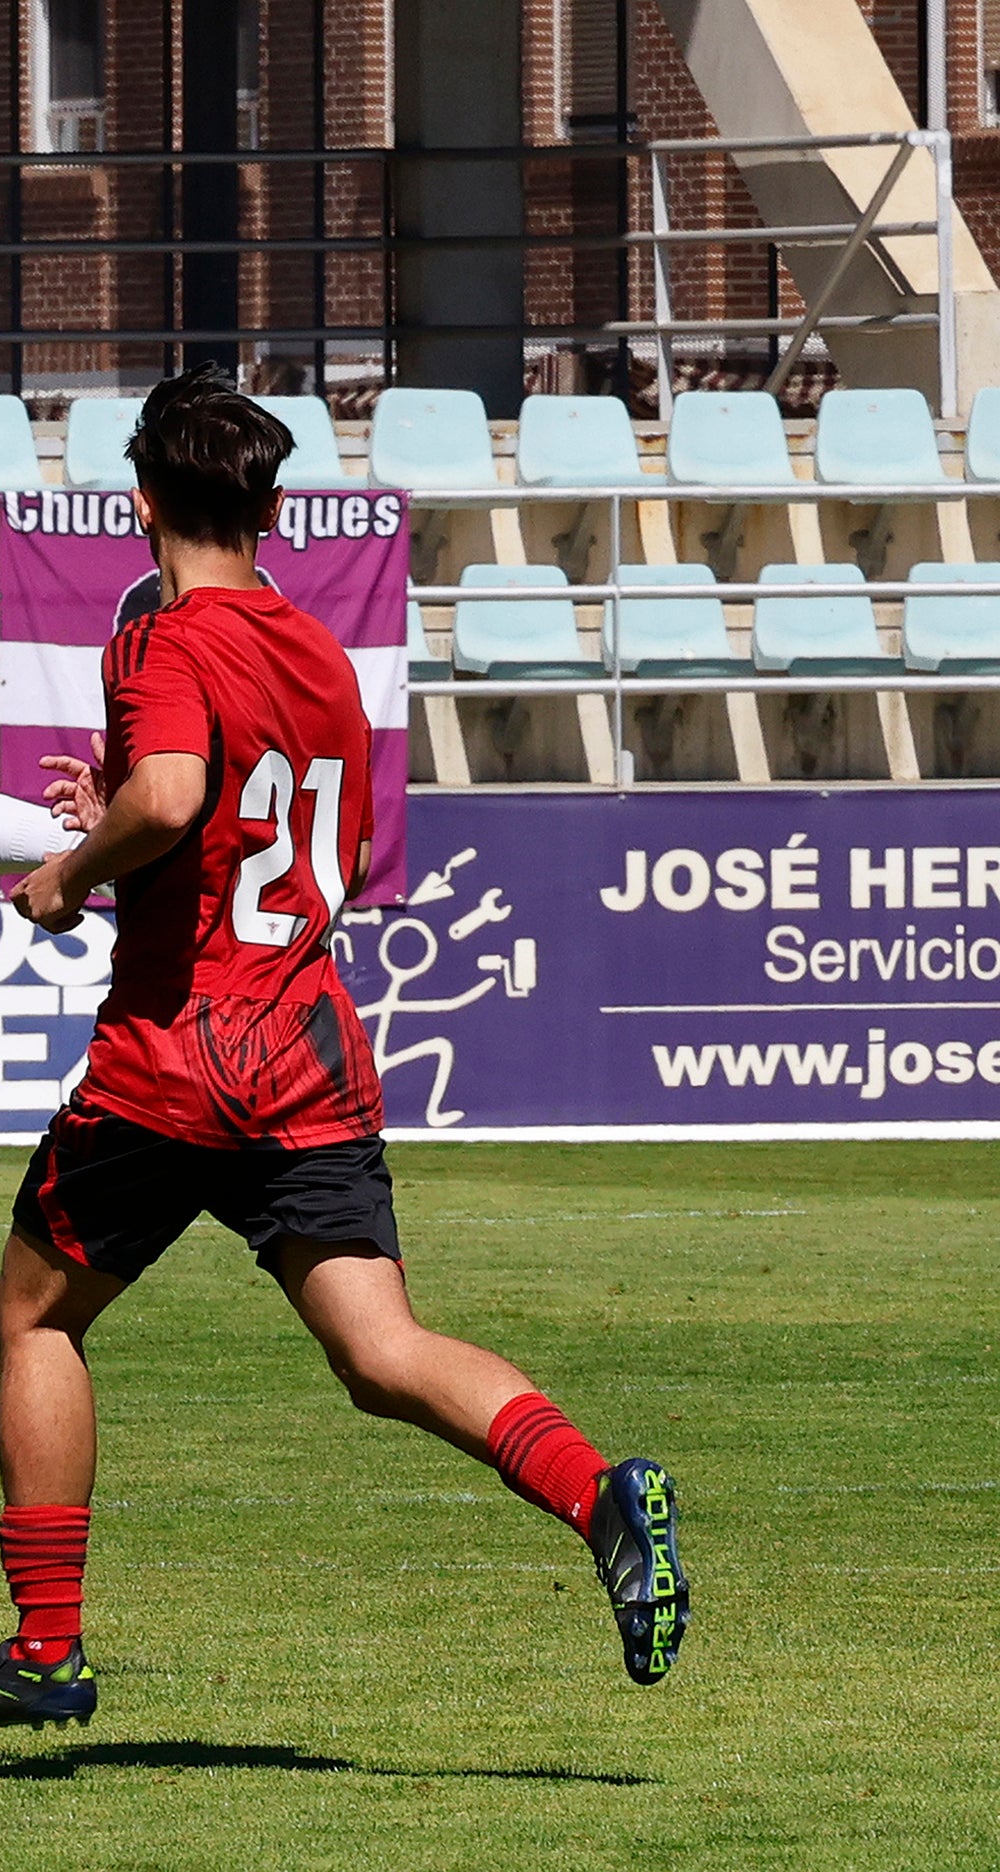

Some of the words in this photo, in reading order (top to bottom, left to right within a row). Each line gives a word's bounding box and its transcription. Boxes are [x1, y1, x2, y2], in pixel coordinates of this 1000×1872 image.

[262, 494, 401, 550] ques
[232, 749, 345, 950] 21
[600, 833, 820, 912] JOSÉ
[850, 847, 1000, 909] HER
